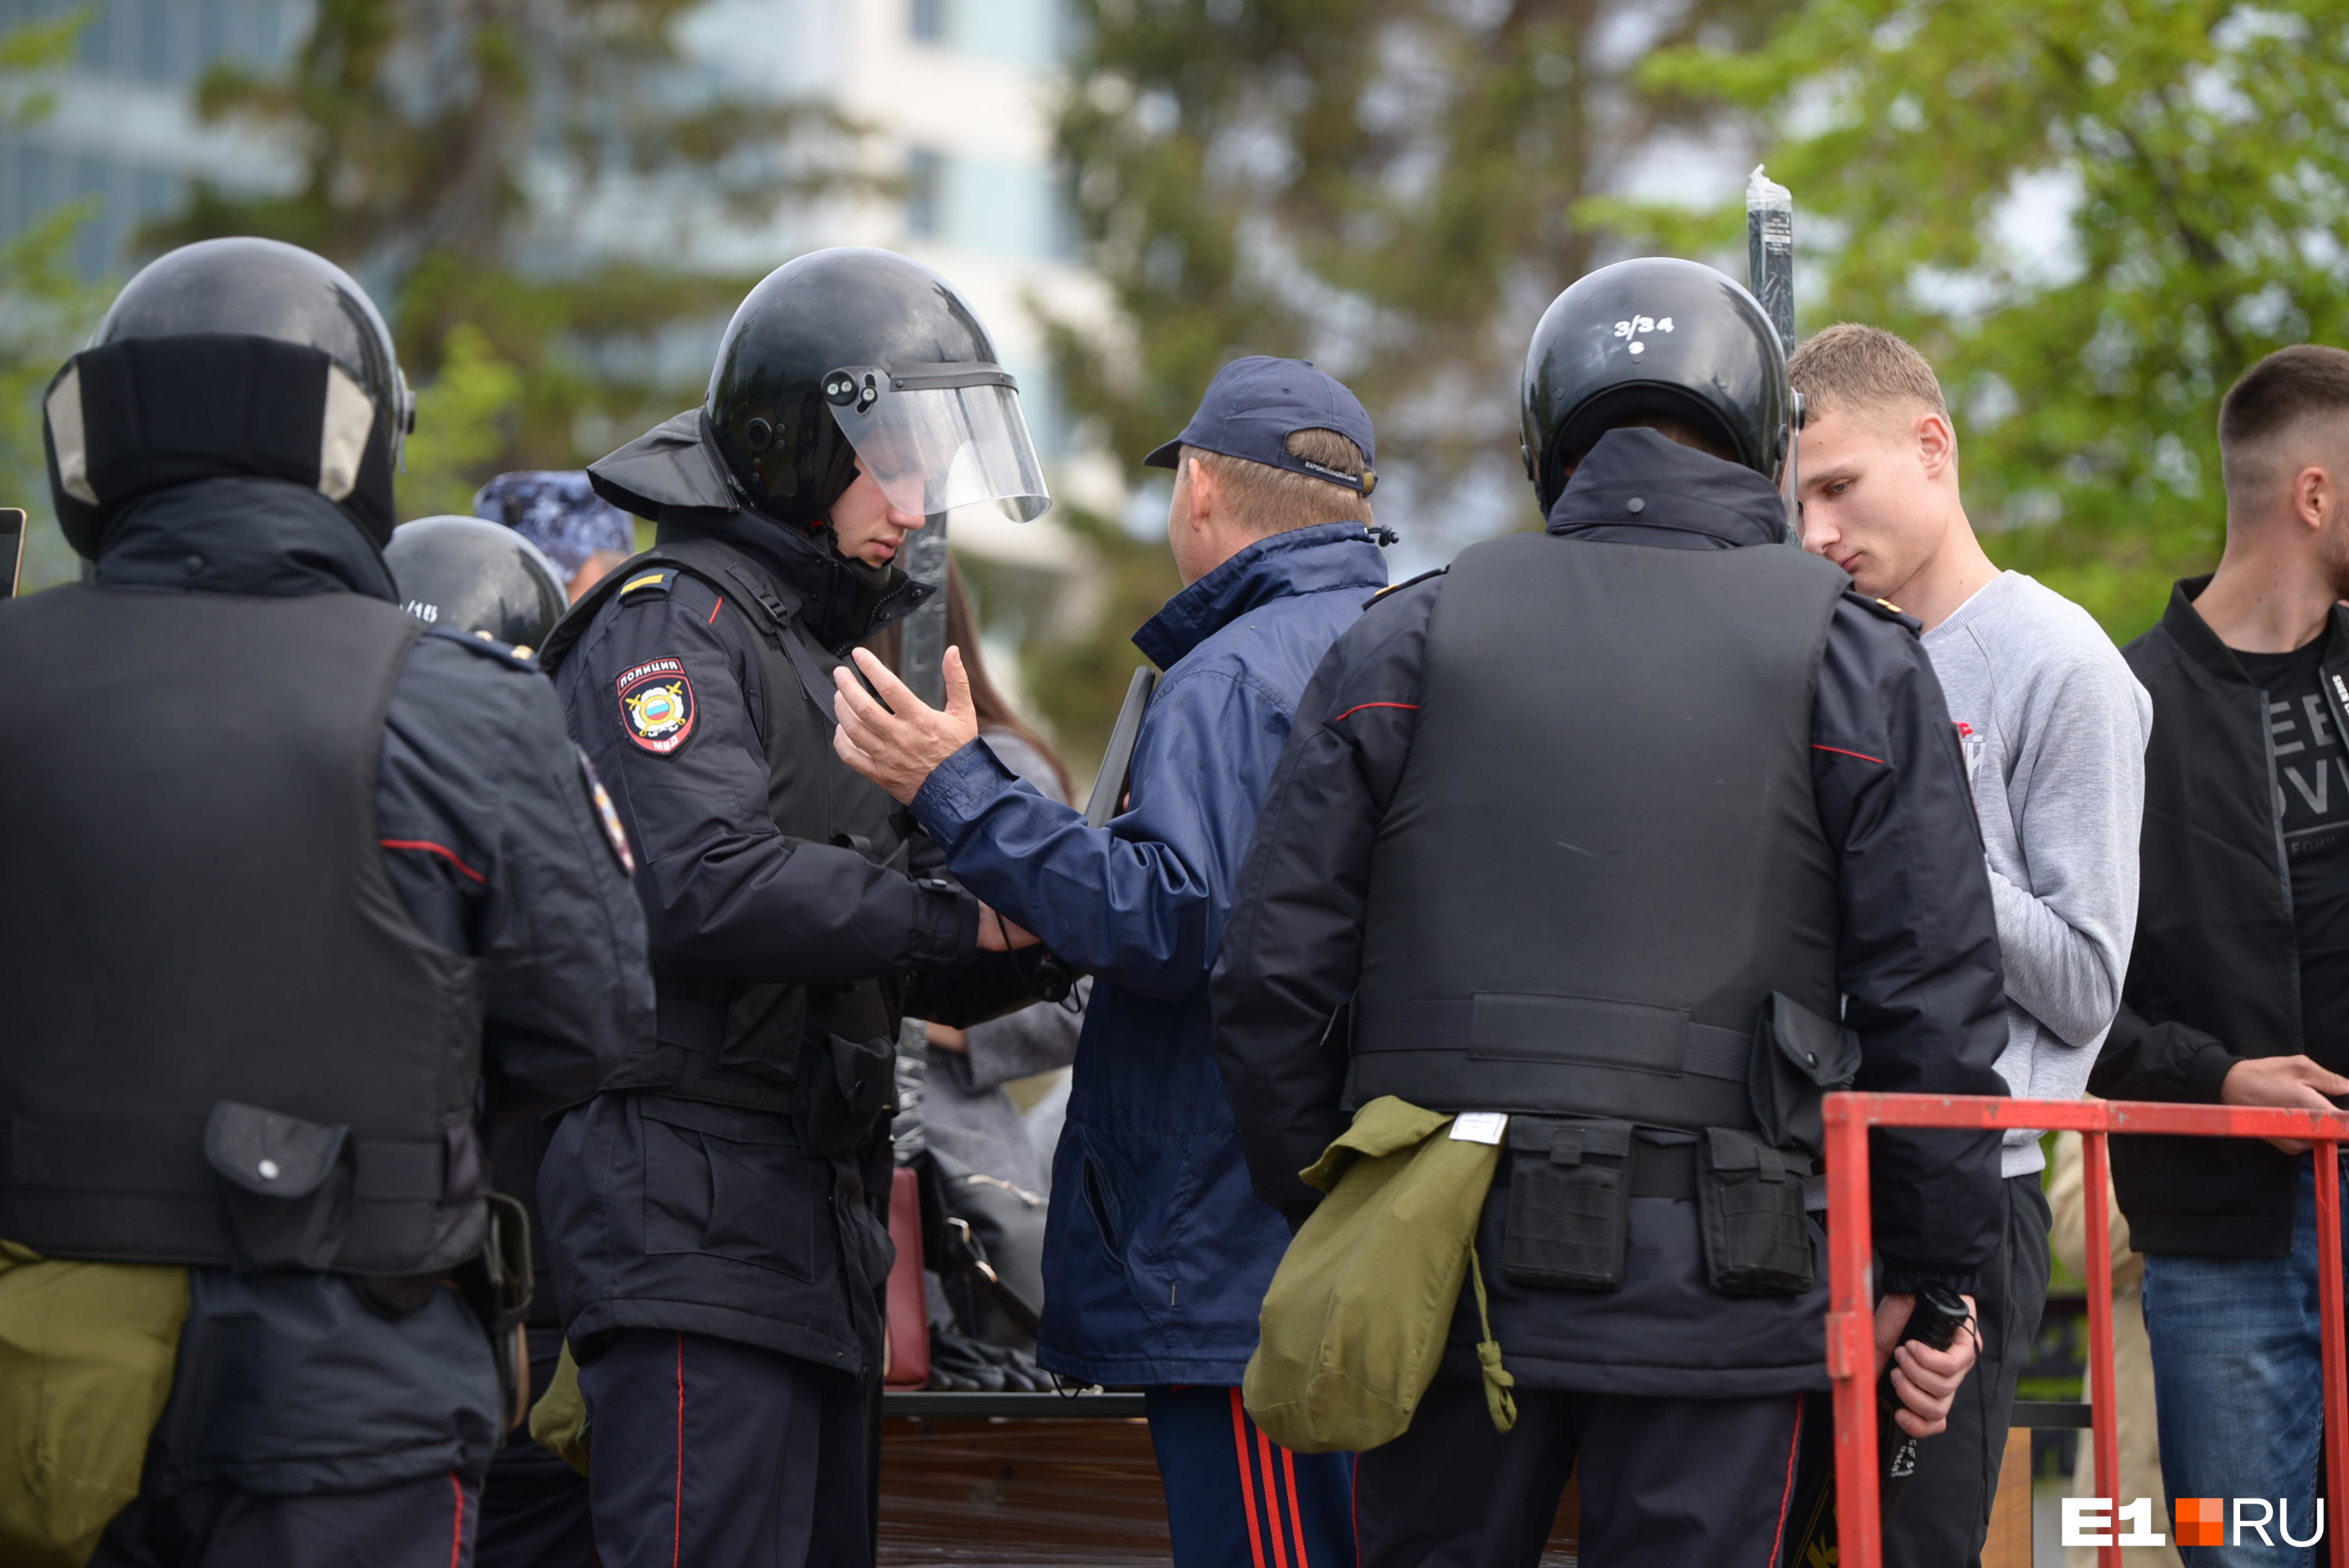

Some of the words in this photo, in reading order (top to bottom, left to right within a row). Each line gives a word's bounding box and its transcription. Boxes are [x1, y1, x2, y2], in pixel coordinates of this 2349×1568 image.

[1614, 314, 1675, 341] 3/34
[620, 661, 678, 688] ПОЛИЦИЯ
[652, 735, 678, 750] МВД
